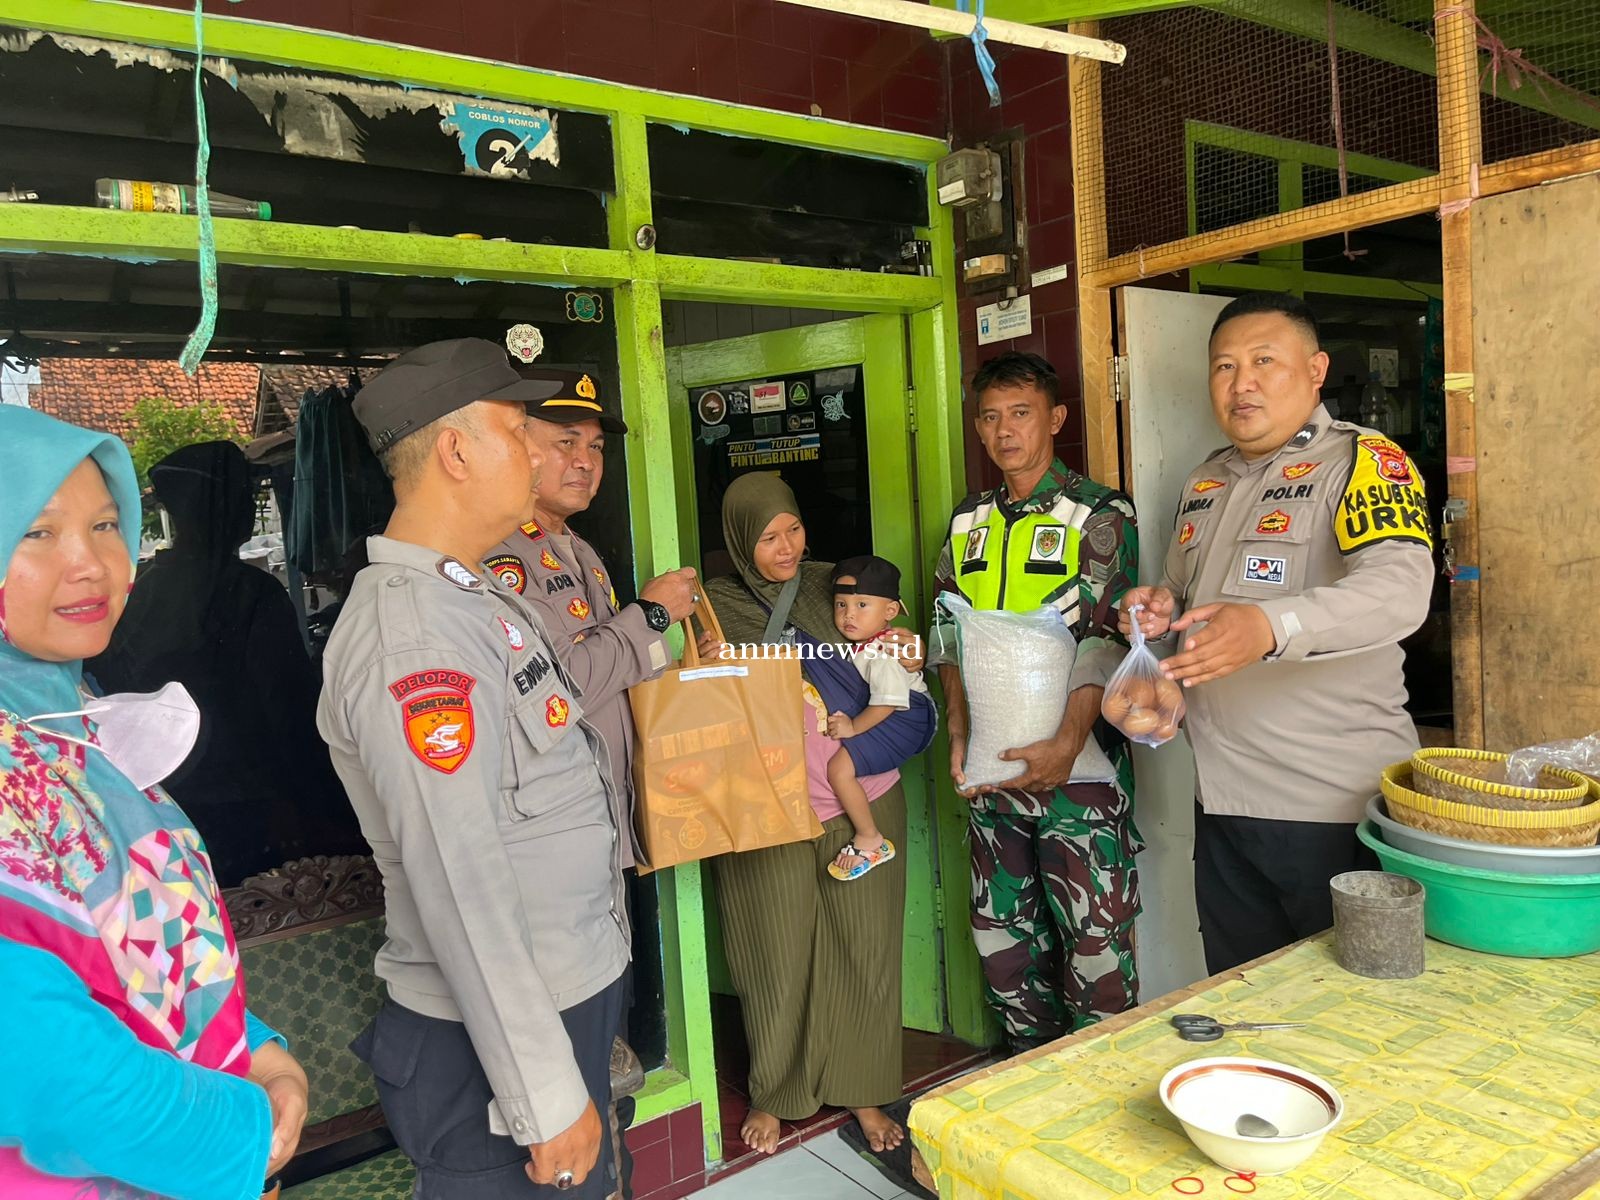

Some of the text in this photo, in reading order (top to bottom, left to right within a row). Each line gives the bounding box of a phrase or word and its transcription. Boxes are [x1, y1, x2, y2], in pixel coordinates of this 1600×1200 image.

[469, 111, 541, 129] COBLOS NOMOR
[489, 139, 518, 176] 2
[728, 437, 801, 453] PINTU TUTUP
[730, 453, 761, 468] PINTU
[1262, 484, 1314, 502] POLRI
[396, 672, 471, 693] PELOPOR
